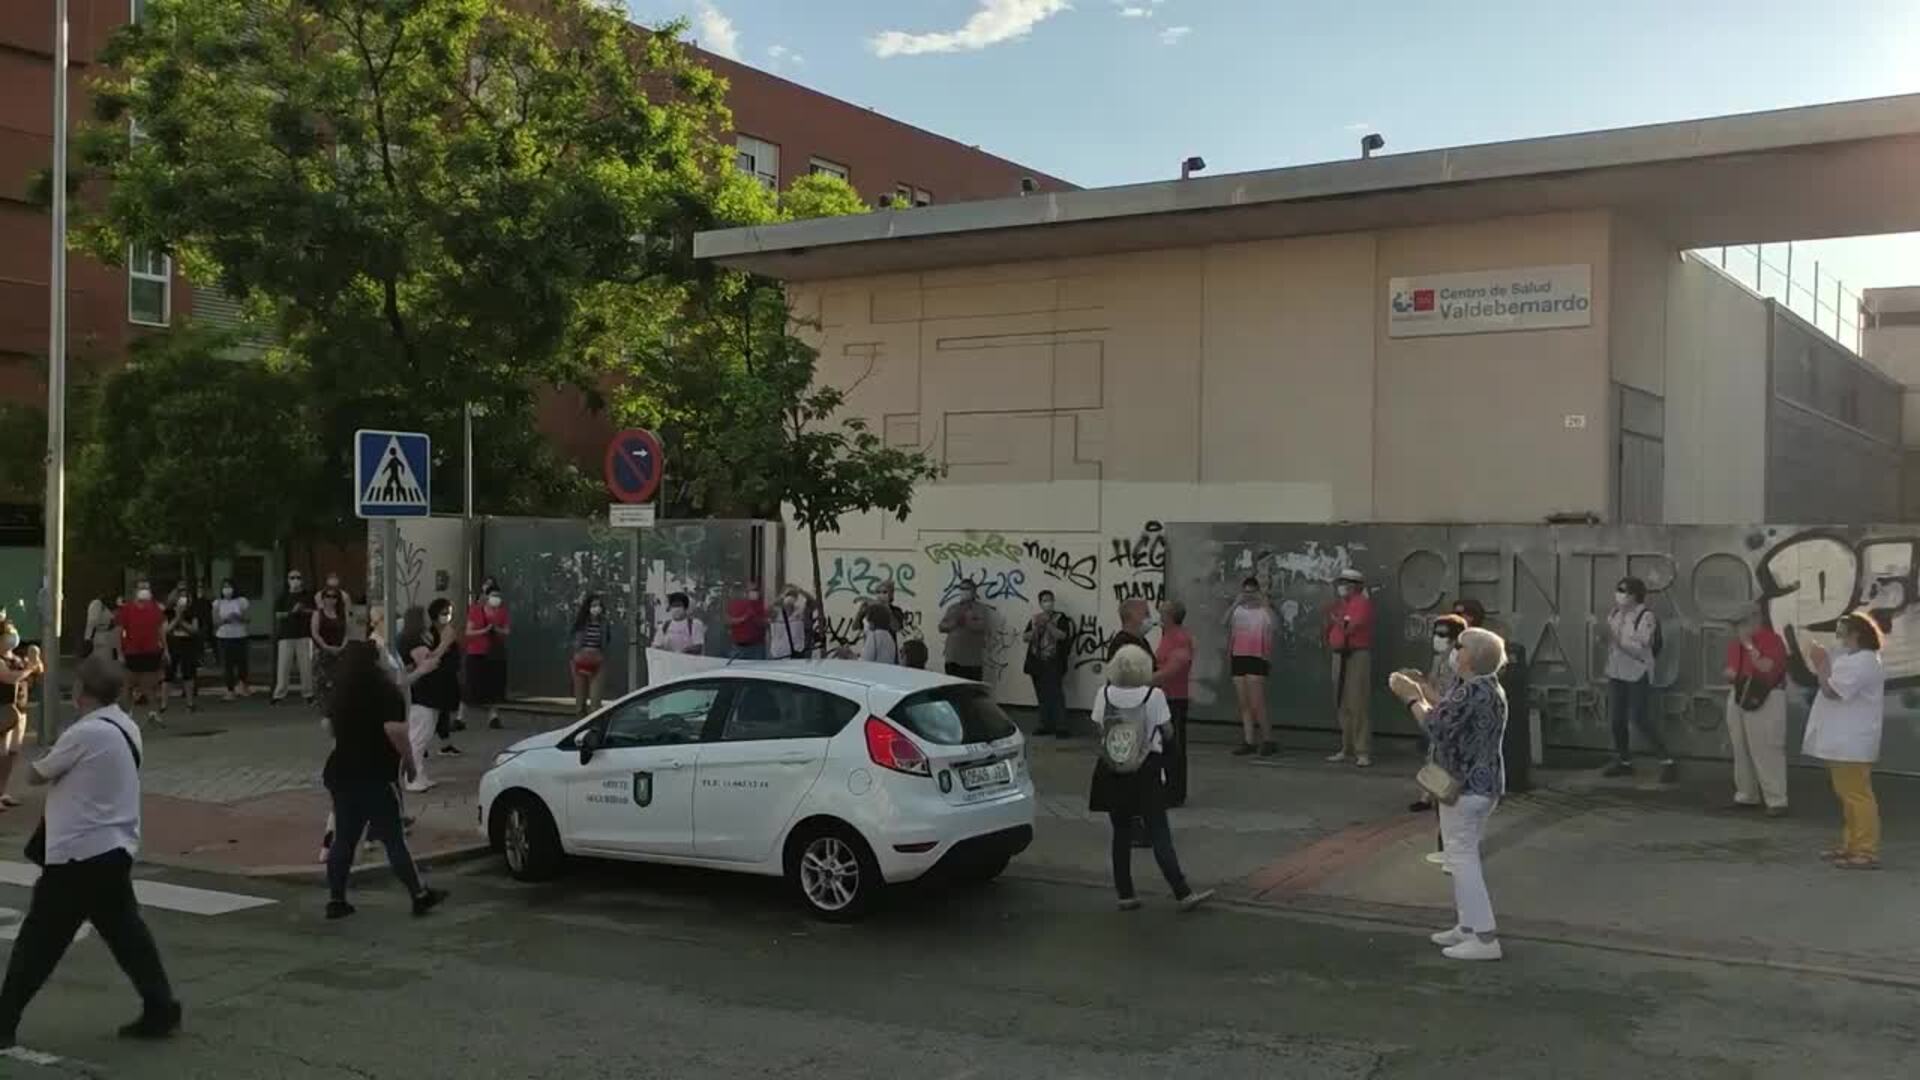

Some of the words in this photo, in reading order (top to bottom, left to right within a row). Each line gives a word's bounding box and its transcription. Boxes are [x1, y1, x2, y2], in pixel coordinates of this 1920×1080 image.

[1440, 287, 1486, 300] Centro
[1489, 285, 1507, 297] de
[1511, 281, 1551, 295] Salud
[1440, 294, 1589, 319] Valdebernardo
[1397, 548, 1754, 621] CENTRO
